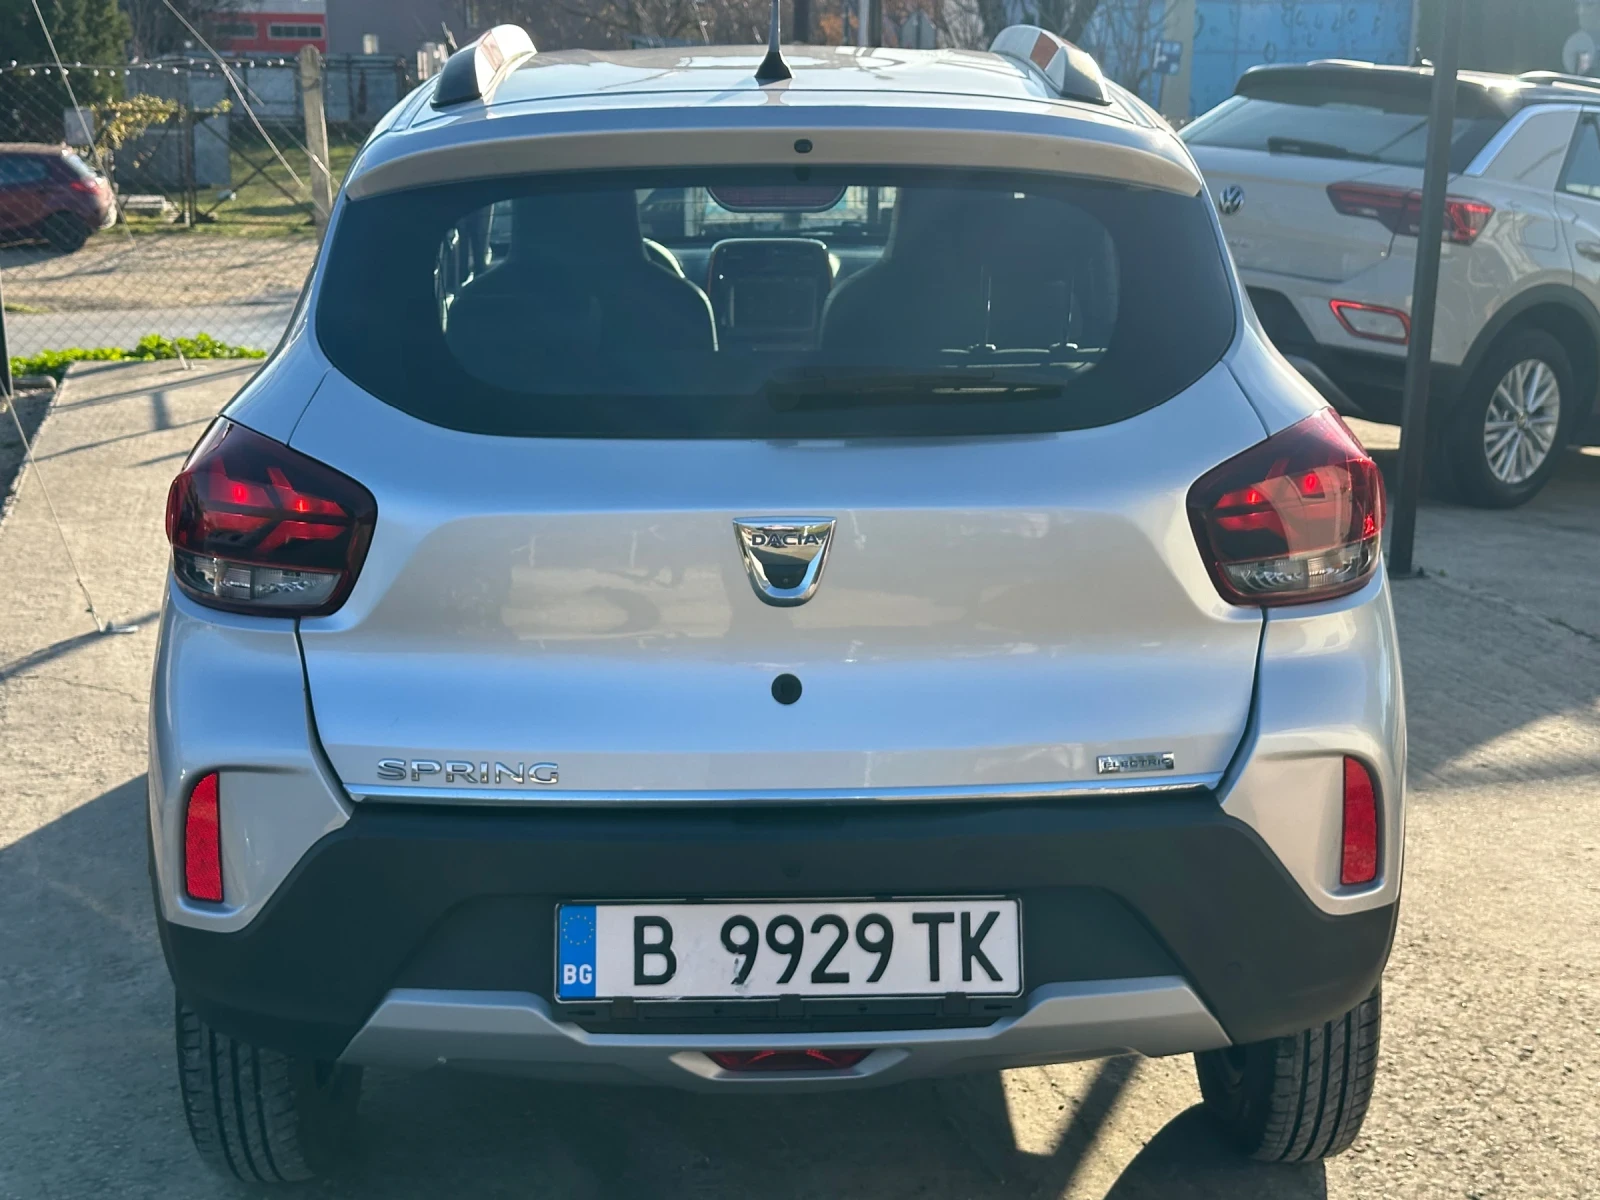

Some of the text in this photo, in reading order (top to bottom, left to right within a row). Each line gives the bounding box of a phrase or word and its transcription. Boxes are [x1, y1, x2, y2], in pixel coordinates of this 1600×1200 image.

[751, 533, 819, 546] DACIA
[377, 758, 559, 784] SPRING
[1102, 757, 1173, 769] ELECTRIC
[633, 911, 1003, 986] B 9929 TK
[563, 964, 592, 985] BG
